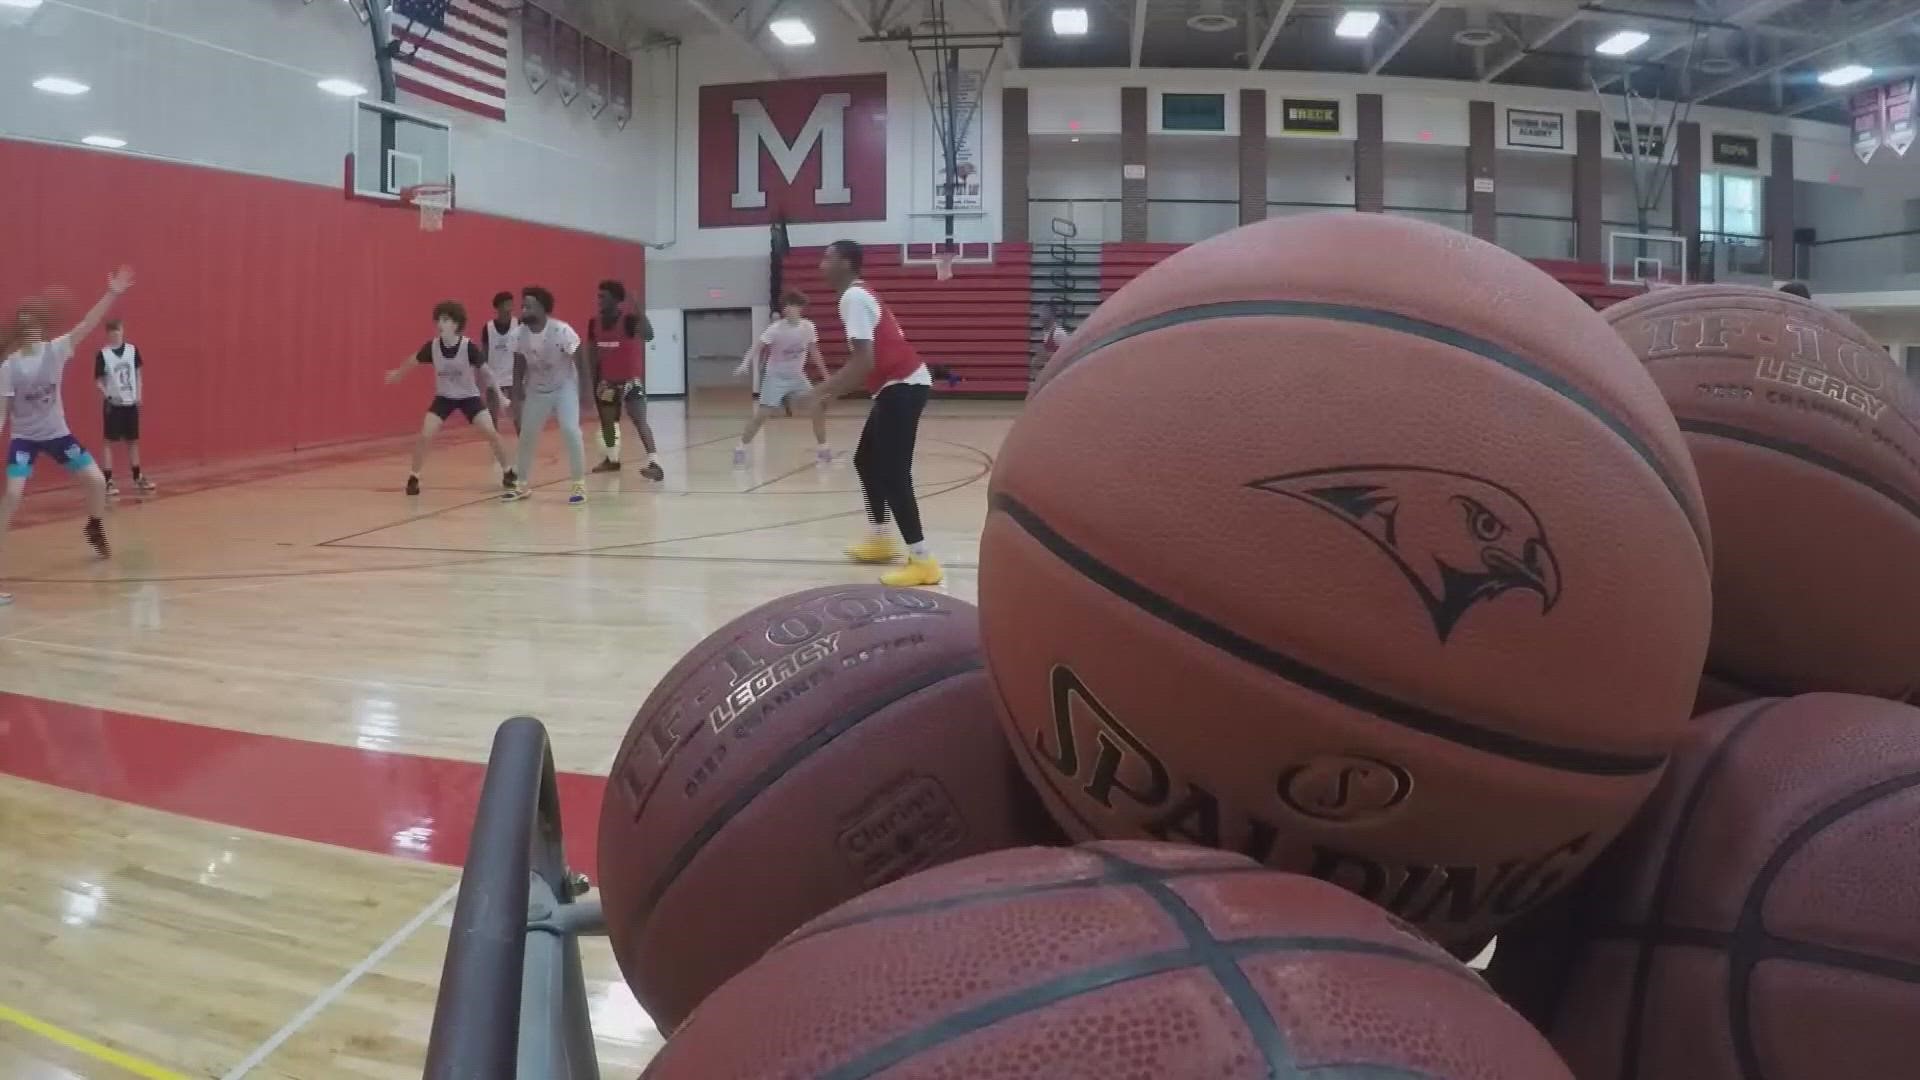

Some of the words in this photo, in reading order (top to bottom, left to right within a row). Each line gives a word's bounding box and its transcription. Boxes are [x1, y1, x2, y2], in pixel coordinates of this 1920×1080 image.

[731, 92, 851, 209] M
[1755, 356, 1887, 420] LEGACY
[708, 630, 841, 735] LEGACY
